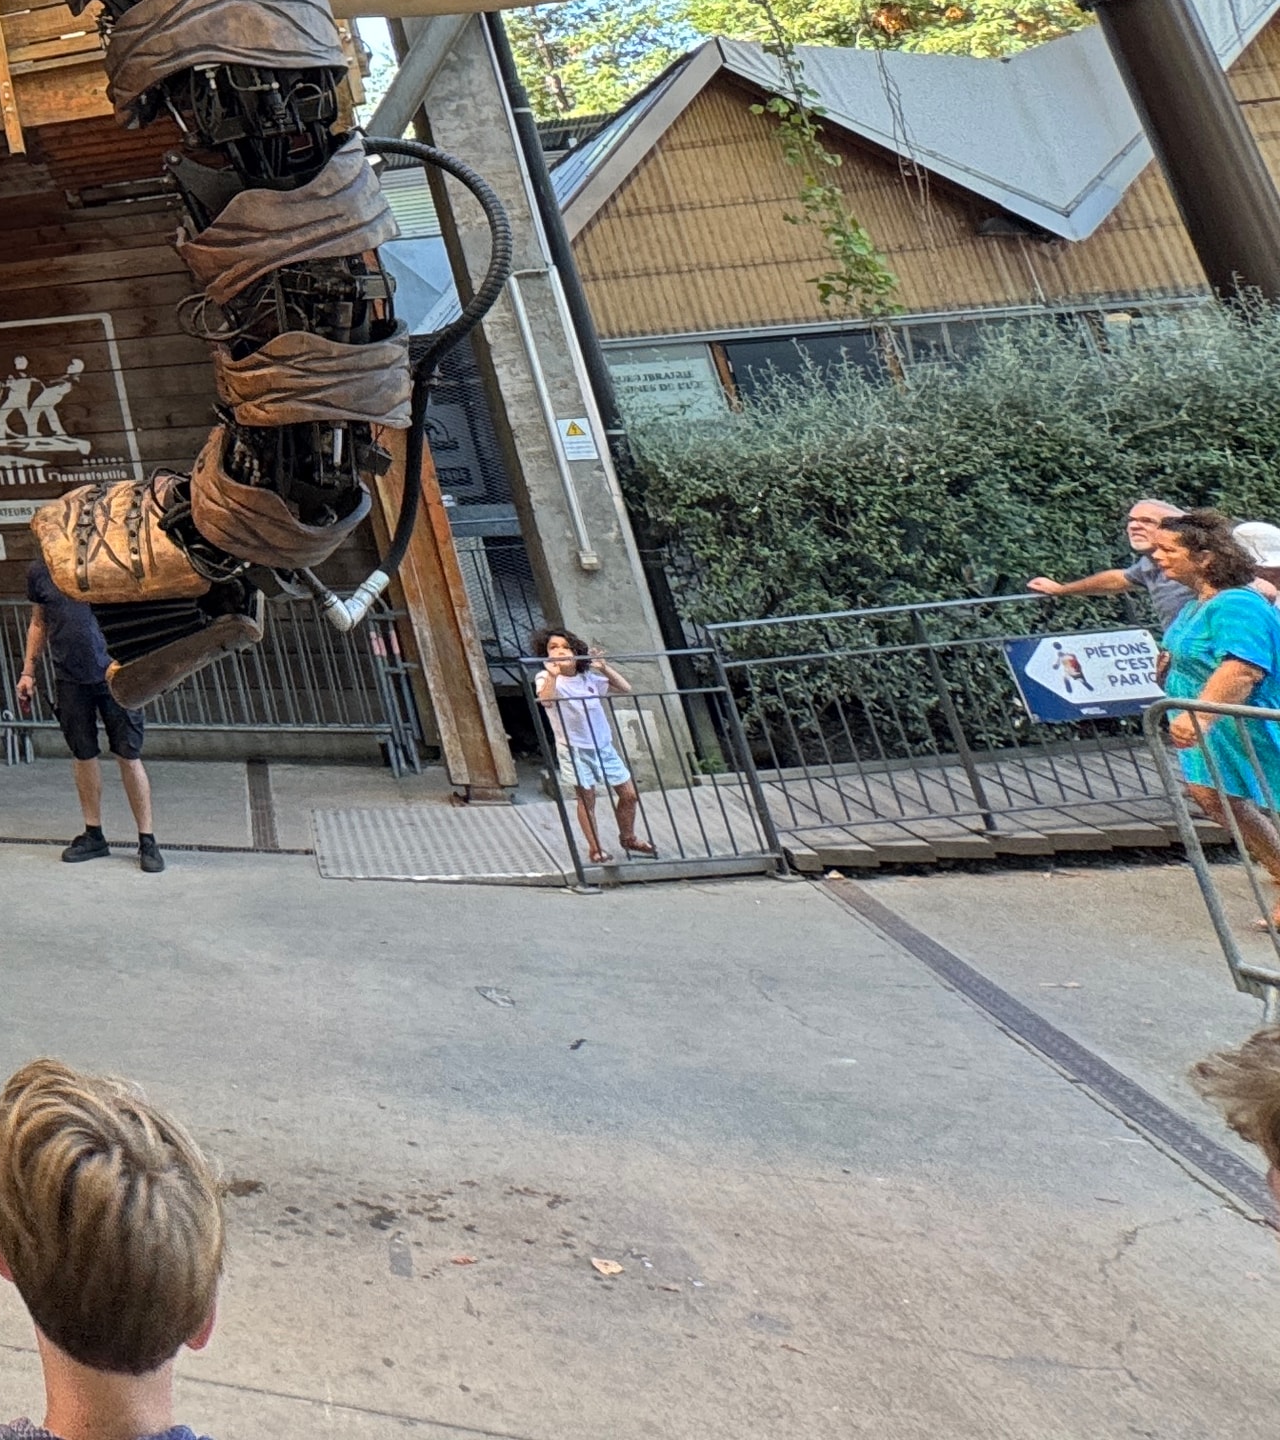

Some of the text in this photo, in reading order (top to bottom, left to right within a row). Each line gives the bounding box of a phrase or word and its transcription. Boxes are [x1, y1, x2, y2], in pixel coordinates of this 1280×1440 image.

[1083, 642, 1151, 659] PIÉTONS
[1114, 656, 1155, 671] C'EST
[1107, 672, 1157, 687] PAR IC
